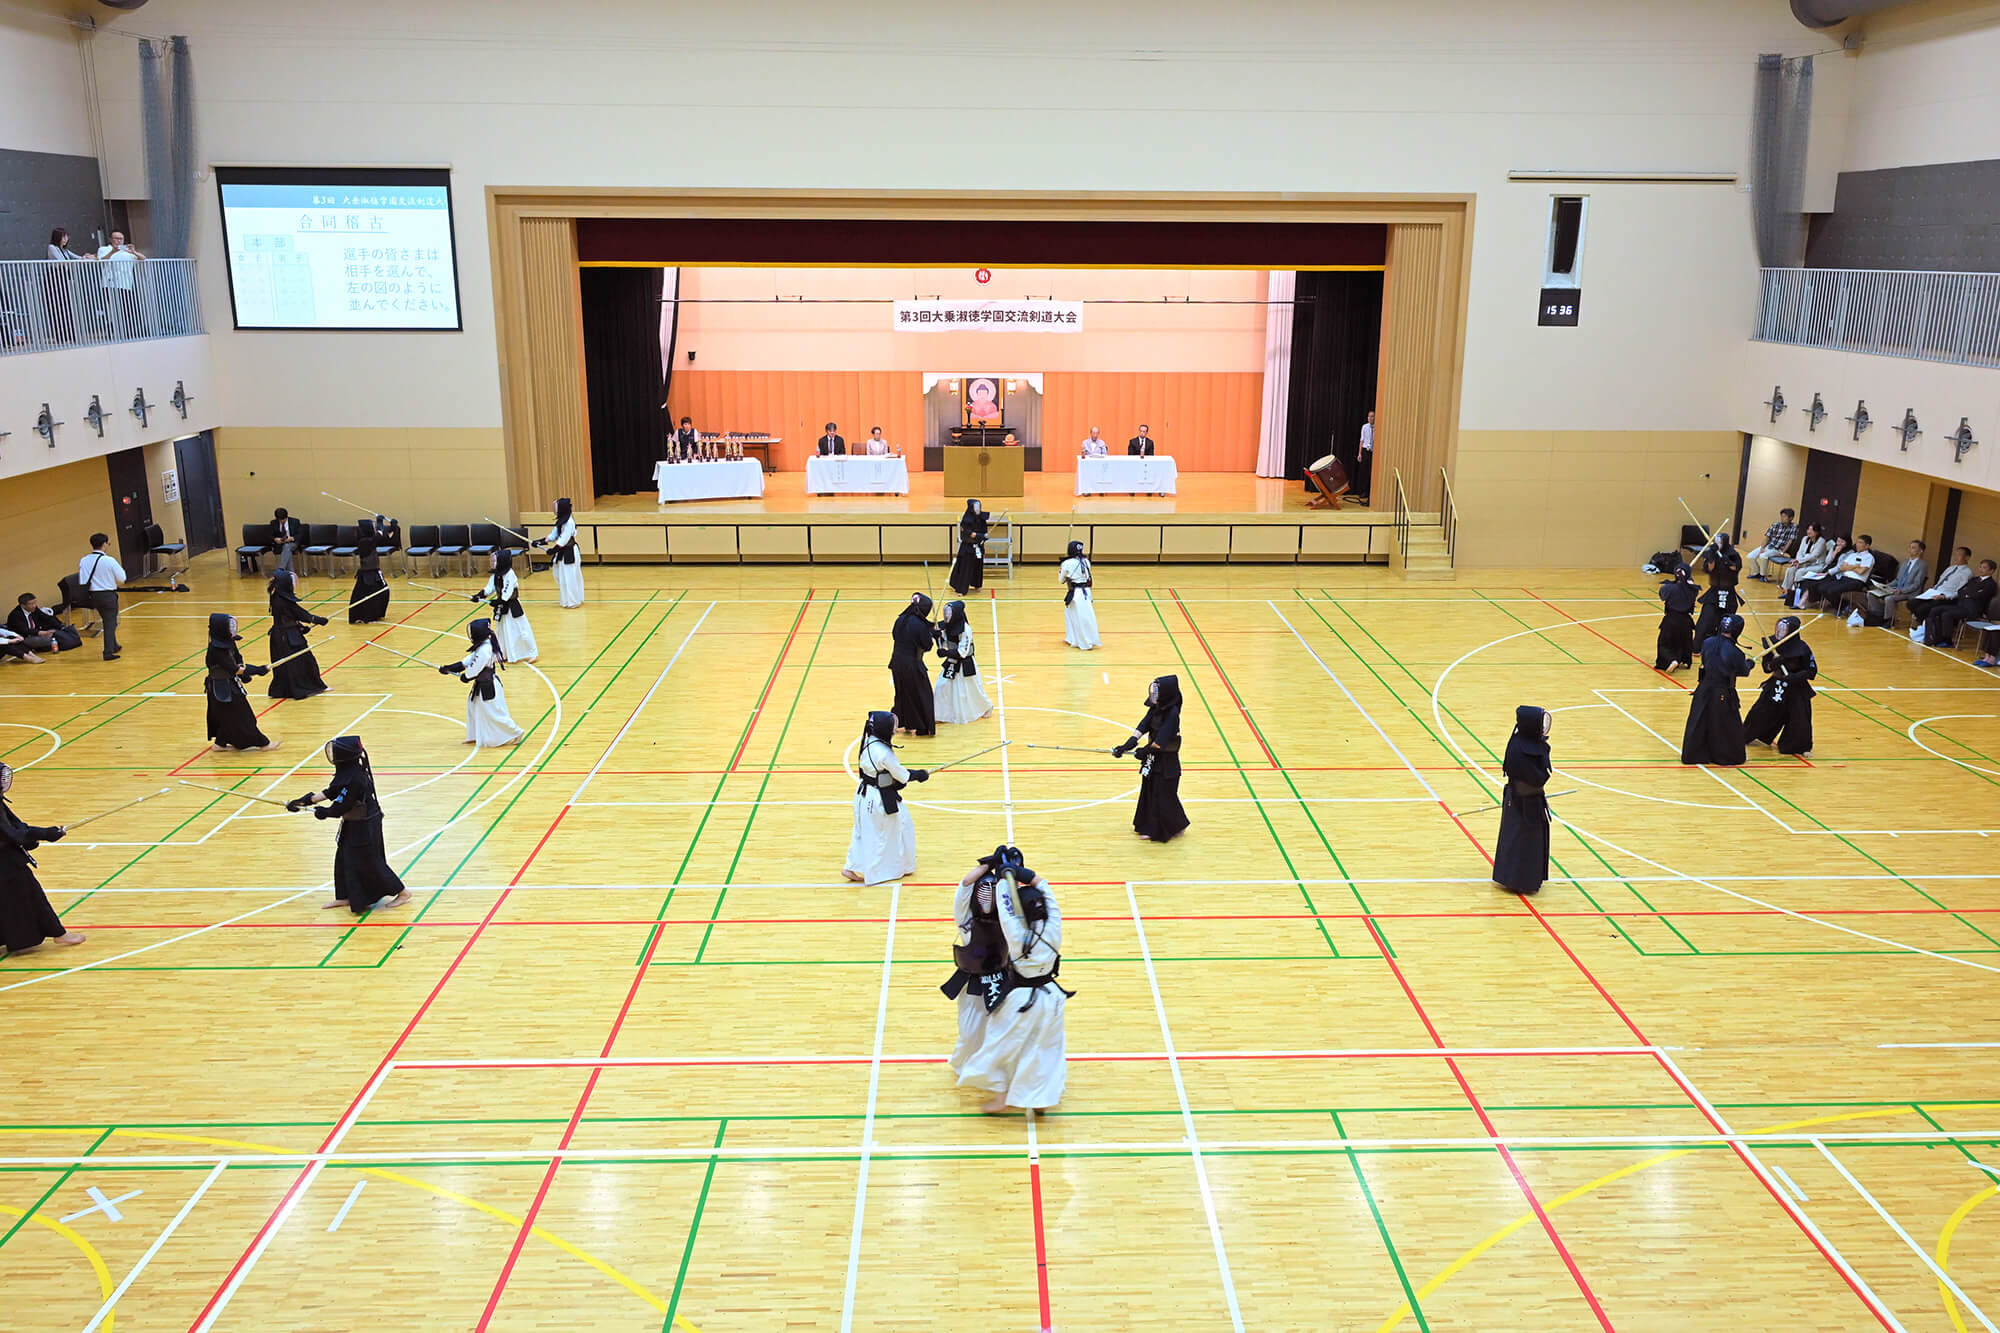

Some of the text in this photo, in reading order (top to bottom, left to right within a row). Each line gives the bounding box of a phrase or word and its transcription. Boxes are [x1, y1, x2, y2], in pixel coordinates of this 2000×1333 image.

[344, 247, 440, 261] 選手の皆さまは
[345, 264, 433, 278] 相手を選んで、
[347, 281, 441, 294] 左の図のように
[350, 298, 450, 312] 並んでください。
[900, 310, 1077, 323] 第3回大乗淑徳学園交流剣道大会
